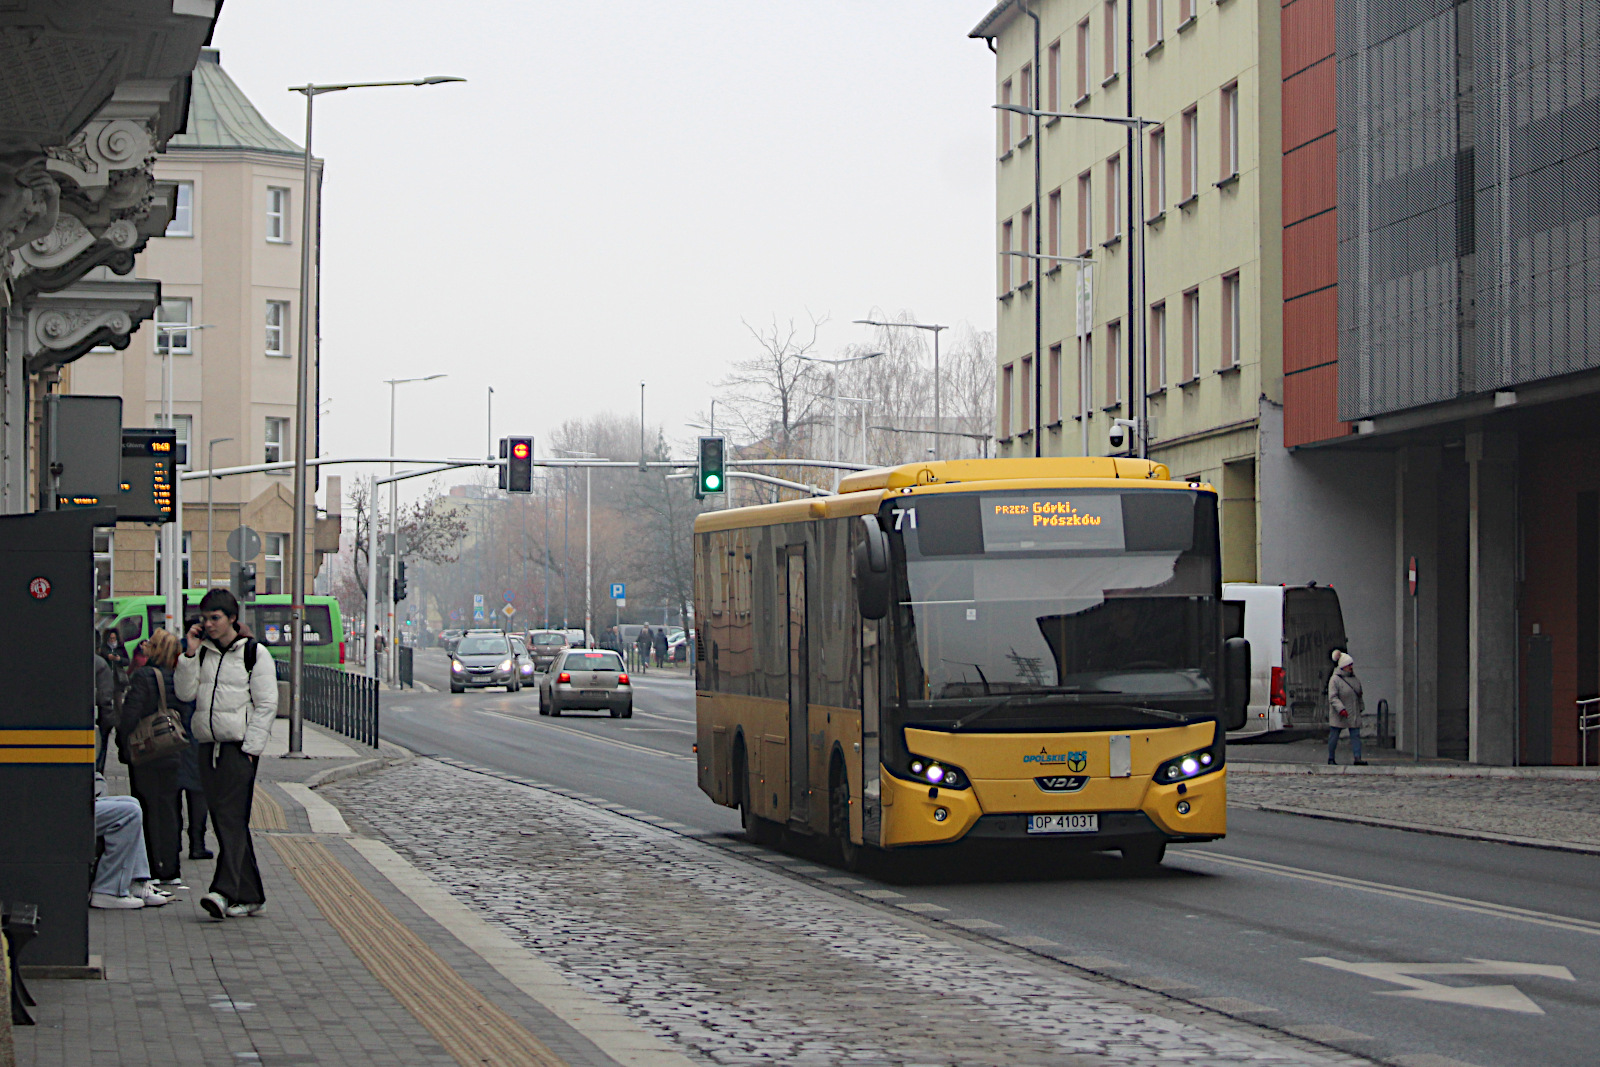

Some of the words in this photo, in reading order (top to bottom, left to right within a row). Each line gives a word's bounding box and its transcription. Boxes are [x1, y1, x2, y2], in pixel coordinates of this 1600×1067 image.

[891, 508, 917, 531] 71
[1032, 514, 1102, 526] Prószków
[1023, 754, 1066, 763] OPOLSKIE
[1067, 750, 1088, 761] PKS
[1042, 777, 1079, 788] VDL
[1035, 816, 1052, 828] OP
[1056, 815, 1095, 828] 4103T
